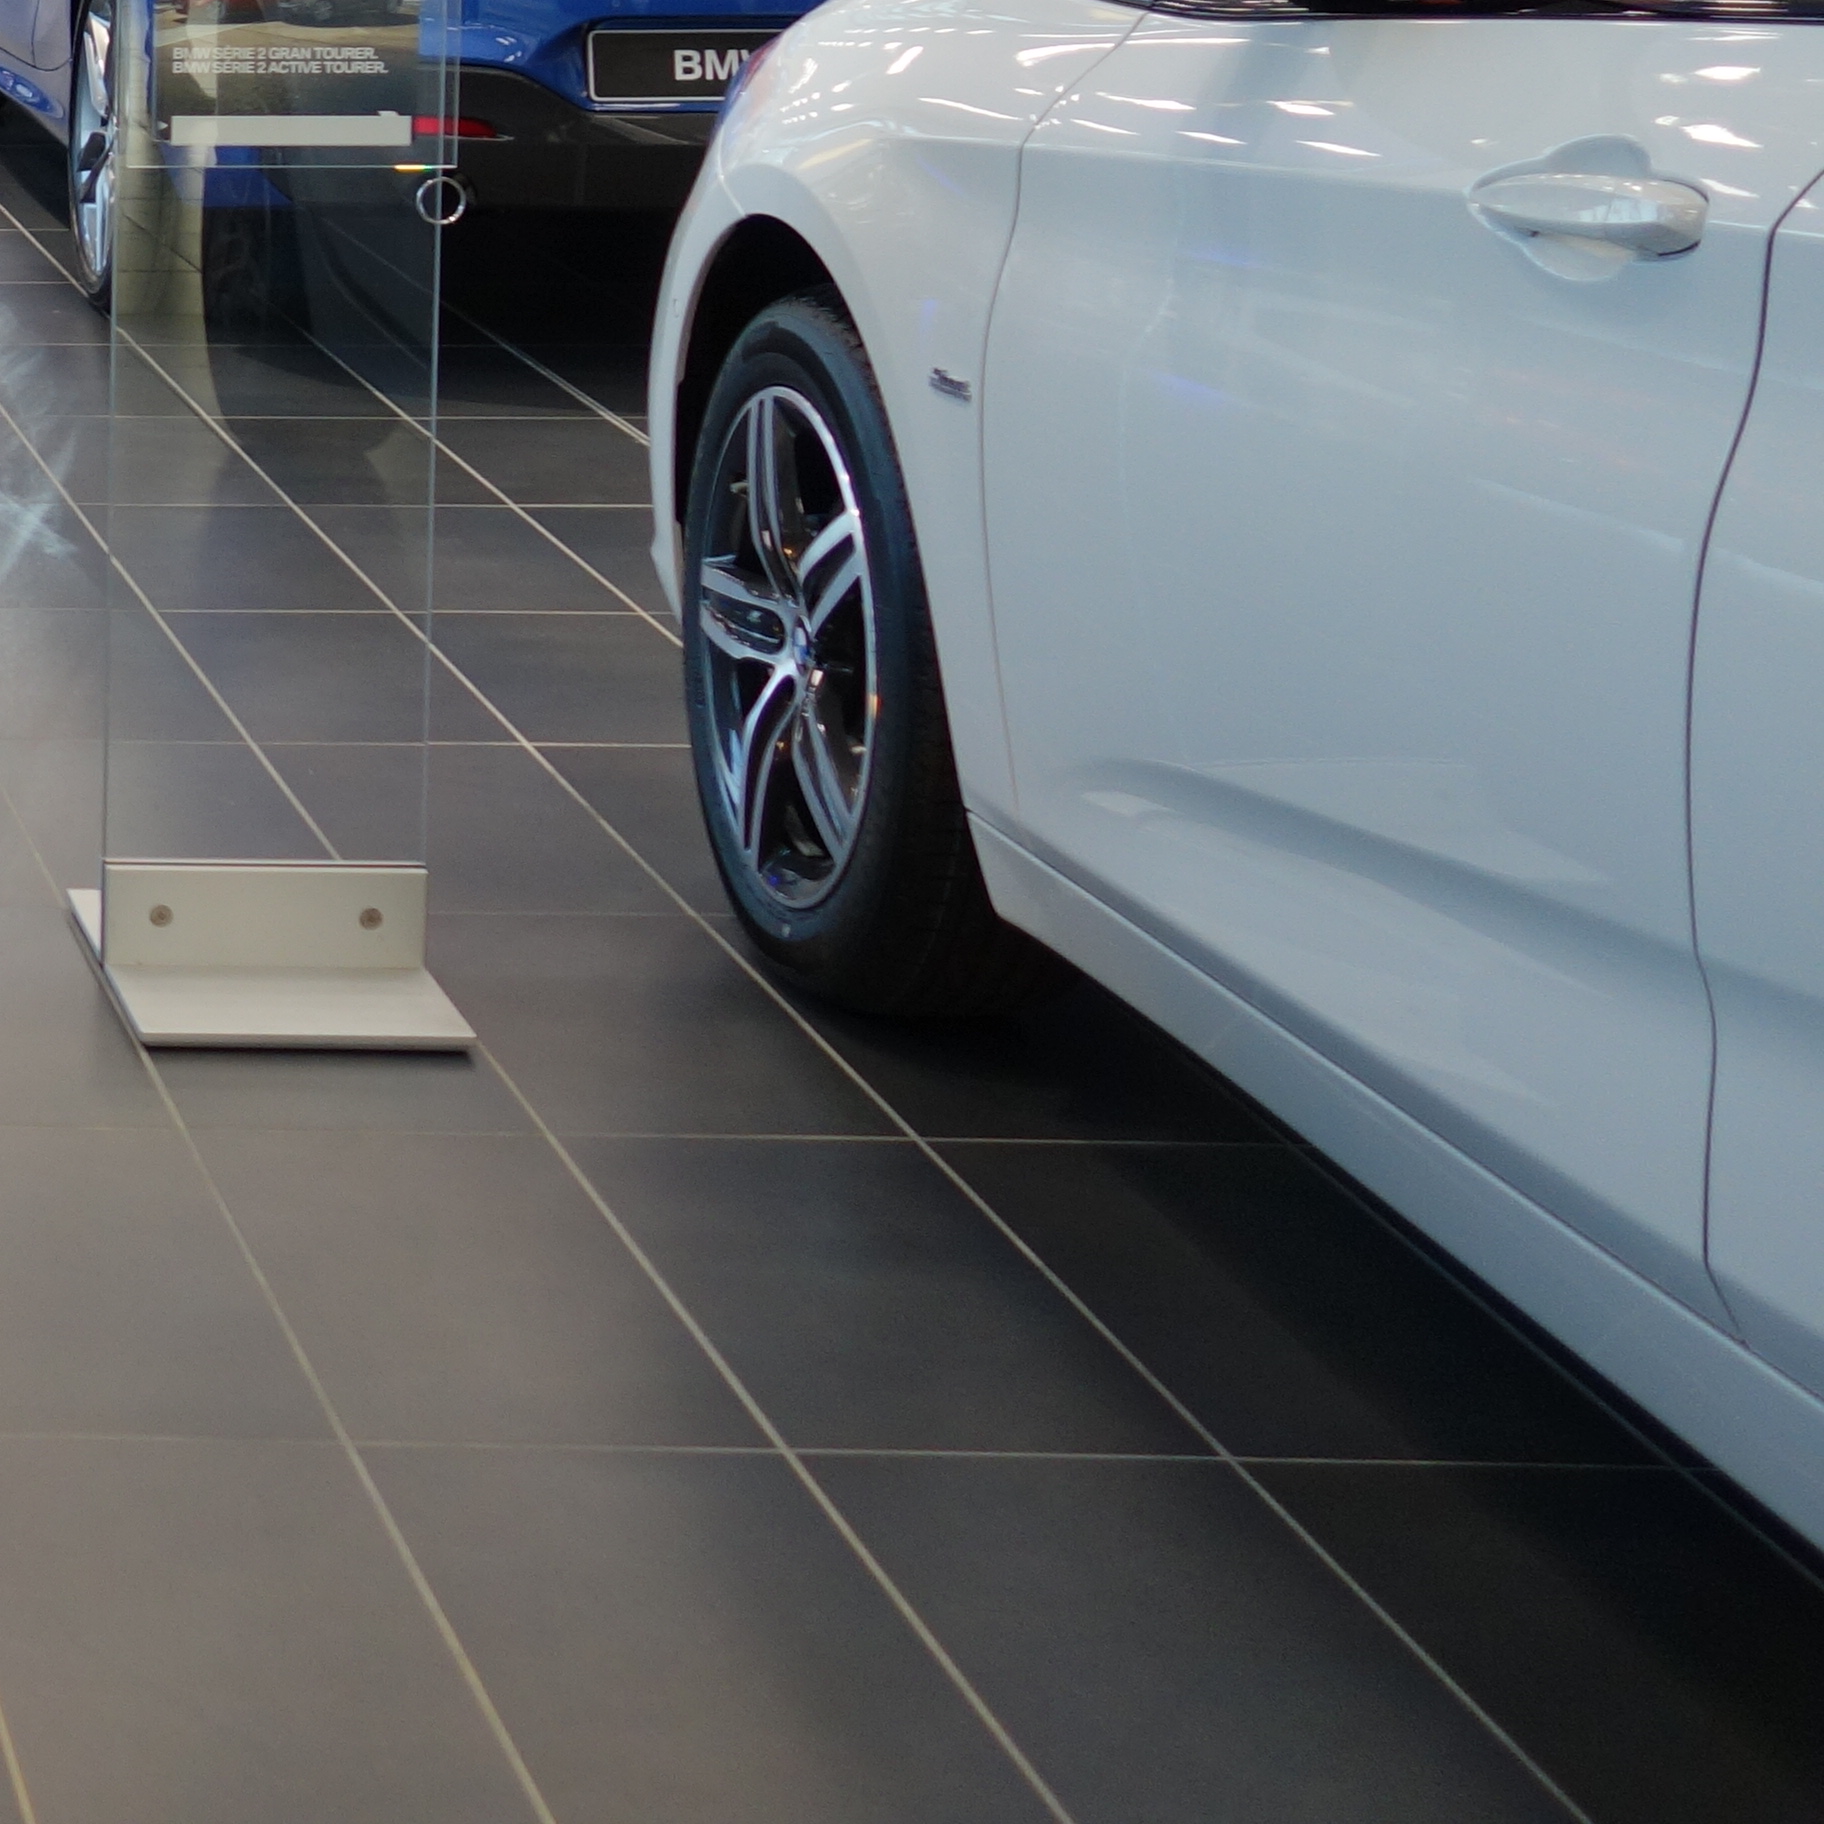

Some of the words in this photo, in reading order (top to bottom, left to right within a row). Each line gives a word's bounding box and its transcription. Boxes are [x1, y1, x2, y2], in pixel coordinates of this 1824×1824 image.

[172, 47, 210, 59] BMW
[212, 44, 255, 59] SÉRIE
[257, 47, 267, 59] 2
[268, 47, 312, 59] GRAN
[315, 47, 379, 59] TOURER.
[172, 62, 211, 74] BMW
[212, 59, 255, 74] SÉRIE
[257, 62, 267, 74] 2
[268, 62, 322, 74] ACTIVE
[324, 62, 389, 74] TOURER.
[673, 48, 750, 81] BM
